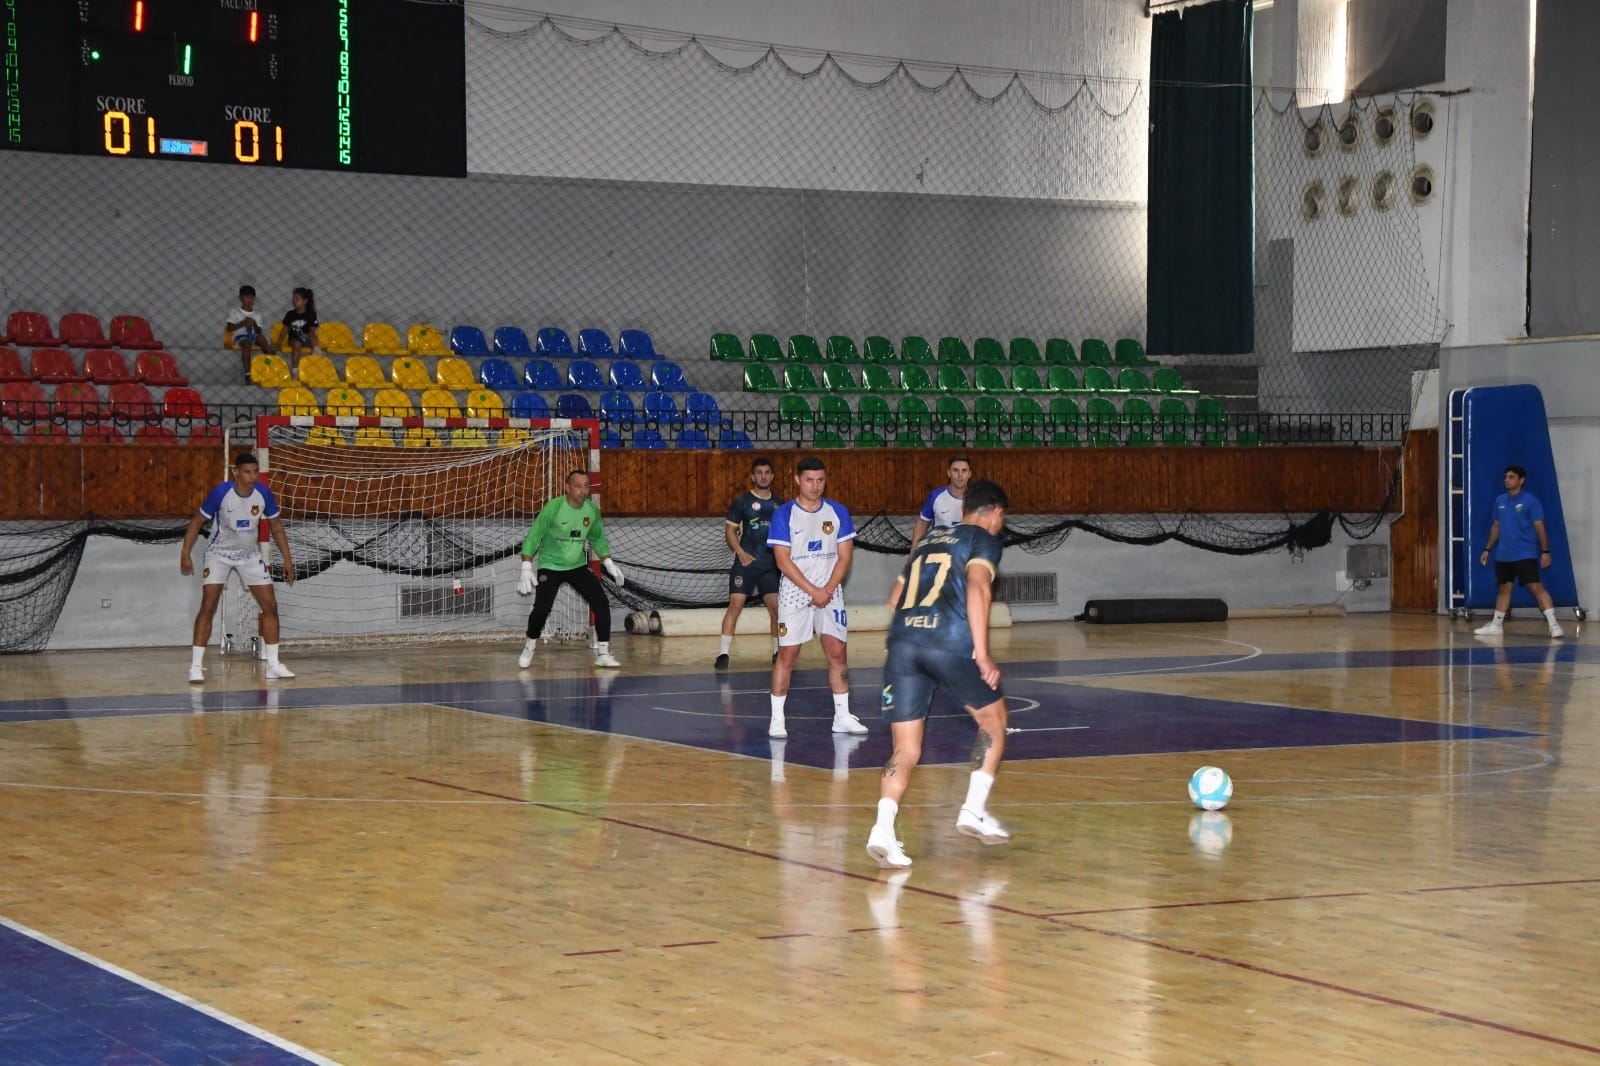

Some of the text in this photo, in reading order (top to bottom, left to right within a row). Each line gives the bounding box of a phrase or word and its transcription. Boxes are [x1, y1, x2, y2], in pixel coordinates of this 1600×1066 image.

[135, 0, 143, 30] 1
[339, 8, 348, 23] 5
[7, 22, 16, 36] 8
[249, 12, 258, 42] 1
[339, 23, 348, 37] 6
[8, 37, 17, 51] 9
[5, 52, 18, 67] 10
[184, 44, 192, 75] 1
[339, 51, 349, 65] 8
[340, 65, 349, 80] 9
[6, 83, 19, 97] 12
[337, 79, 350, 94] 10
[96, 94, 146, 115] SCORE
[338, 94, 350, 108] 11
[8, 113, 21, 127] 14
[224, 104, 272, 123] SCORE
[338, 107, 350, 122] 12
[9, 128, 21, 143] 15
[104, 111, 156, 155] 01
[338, 121, 351, 136] 13
[234, 120, 284, 164] 01
[339, 136, 351, 150] 14
[339, 149, 351, 164] 15
[901, 552, 952, 610] 17
[833, 609, 848, 627] 10
